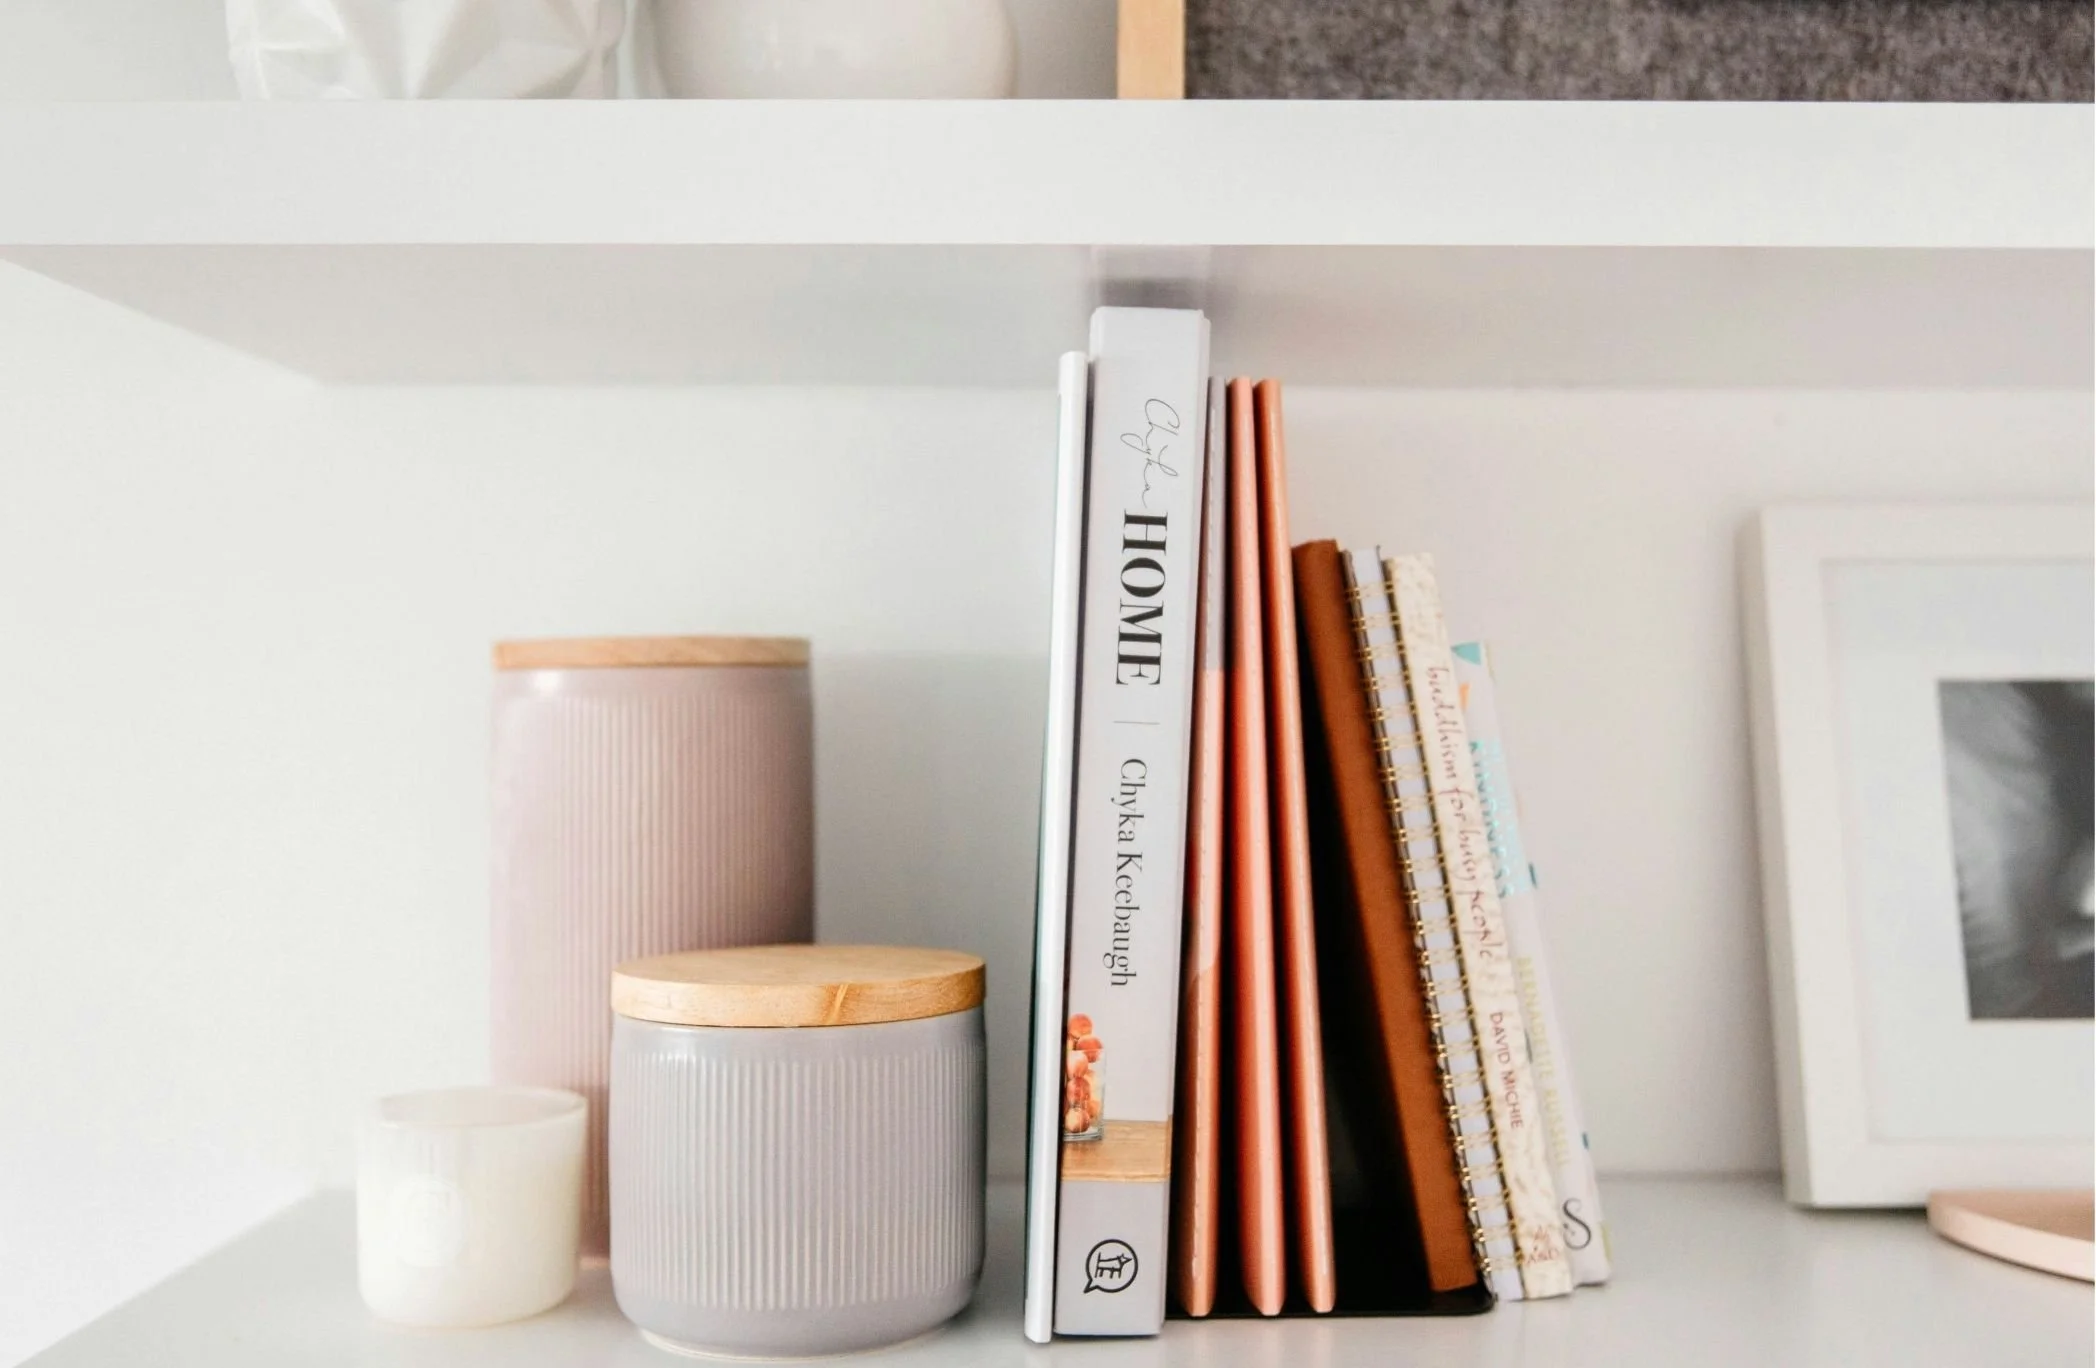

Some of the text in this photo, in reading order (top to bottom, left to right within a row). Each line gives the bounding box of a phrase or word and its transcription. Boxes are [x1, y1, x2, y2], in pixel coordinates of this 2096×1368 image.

[1114, 397, 1181, 686] Chyka HOME
[1102, 758, 1148, 988] Chyka Keebaugh
[1427, 666, 1504, 958] buddhism for busy people
[1489, 1012, 1524, 1129] DAVID MICHIE
